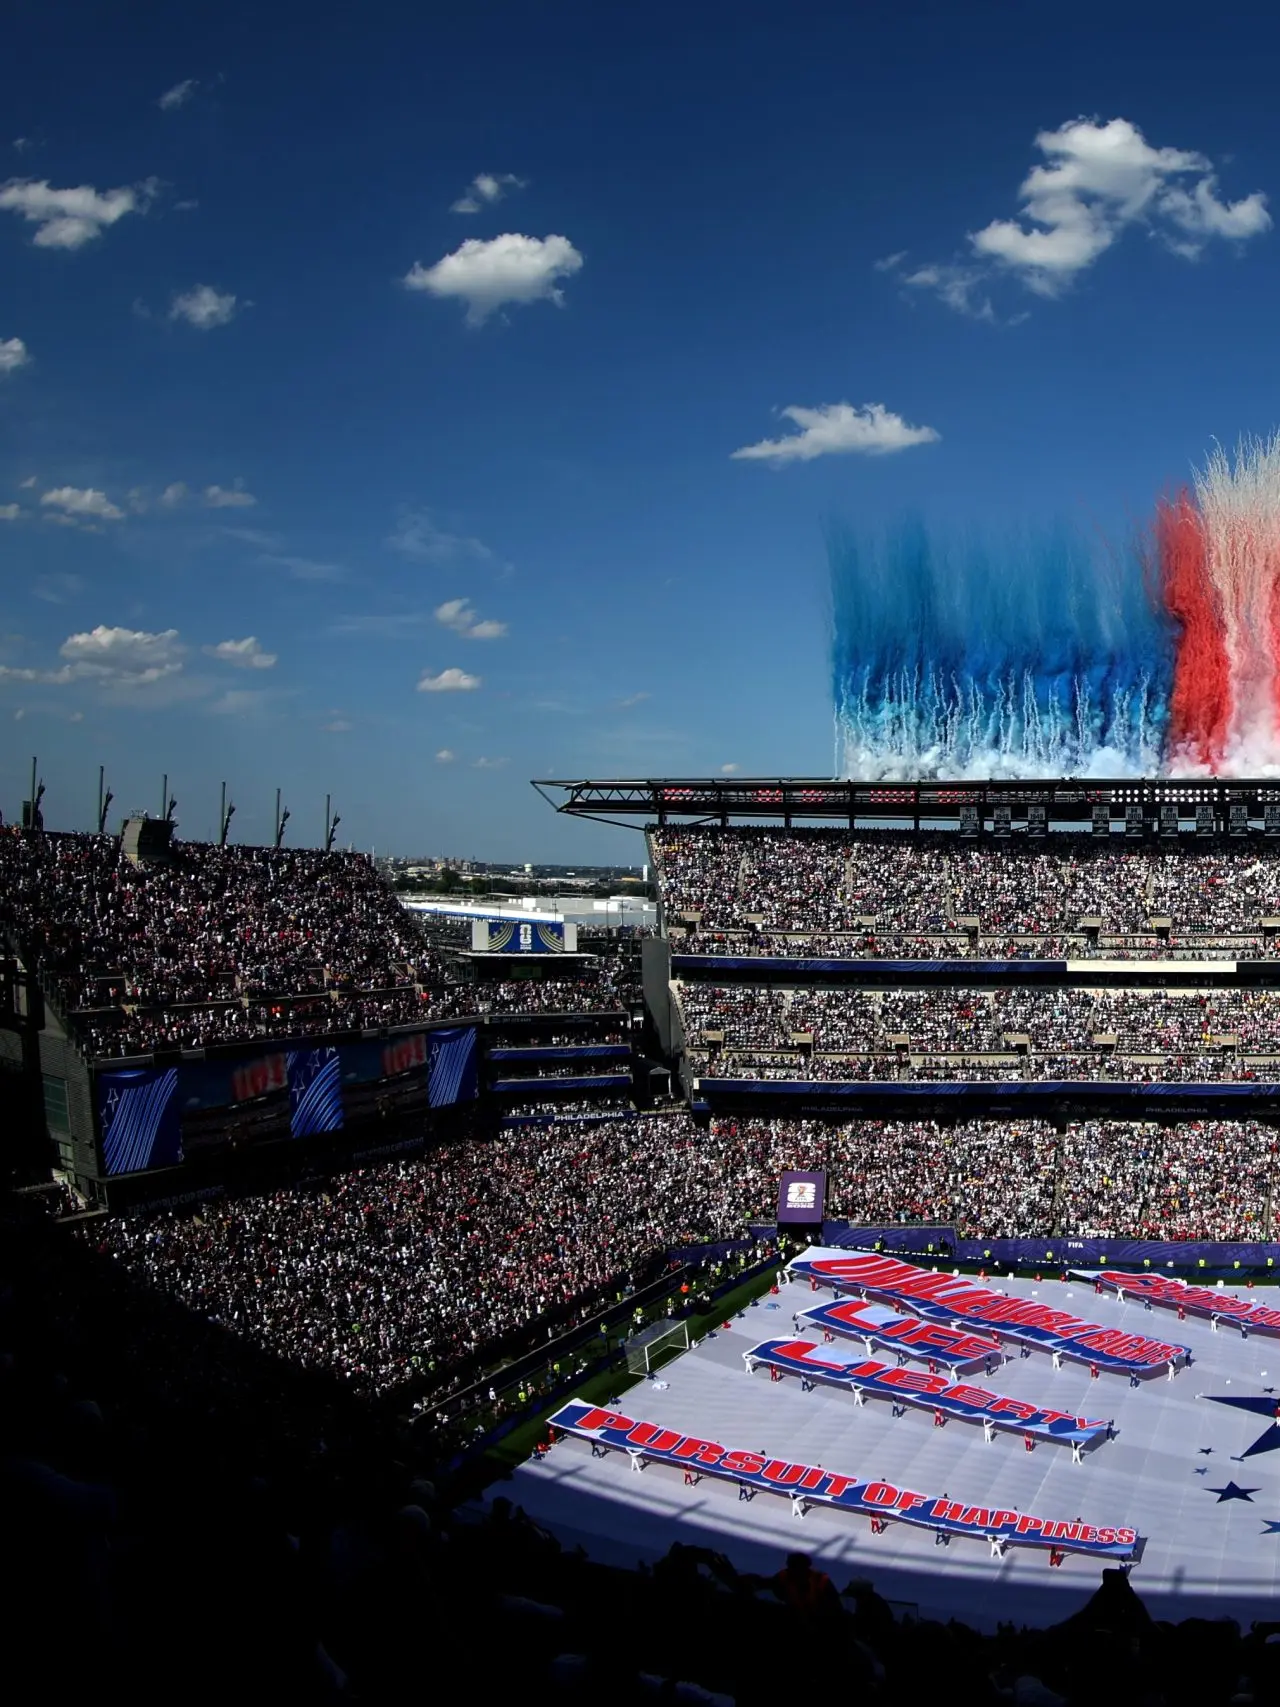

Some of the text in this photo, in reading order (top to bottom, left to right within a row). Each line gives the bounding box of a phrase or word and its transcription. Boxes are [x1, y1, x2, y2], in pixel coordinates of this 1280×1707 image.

[554, 1111, 625, 1122] PHILADELPHIA
[1145, 1106, 1209, 1114] PHILADELPHIA
[811, 1254, 1184, 1364] UNALIENABLE RIGHTS
[825, 1300, 1003, 1360] LIFE
[771, 1339, 1107, 1431] LIBERTY
[576, 1406, 1138, 1545] PURSUIT OF HAPPINESS
